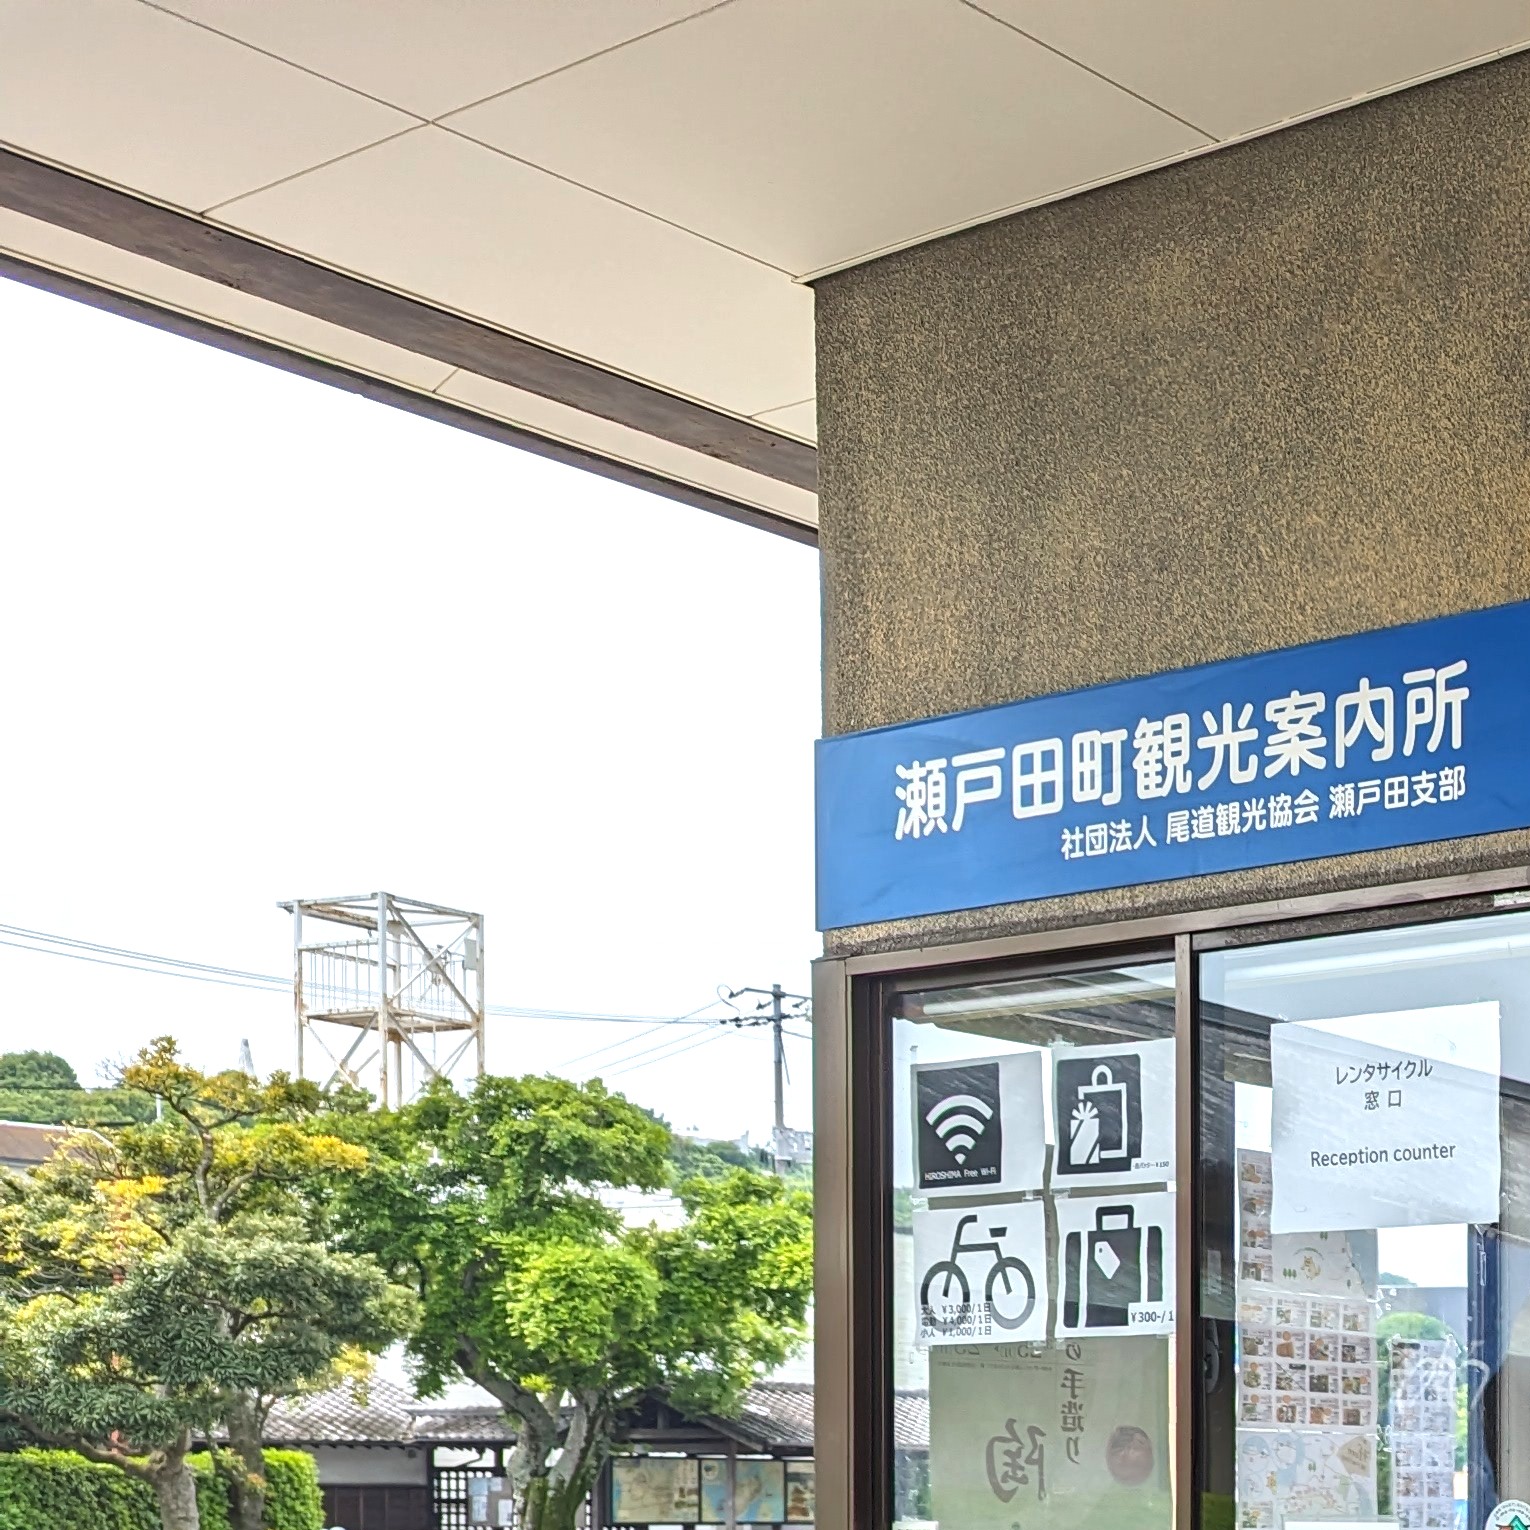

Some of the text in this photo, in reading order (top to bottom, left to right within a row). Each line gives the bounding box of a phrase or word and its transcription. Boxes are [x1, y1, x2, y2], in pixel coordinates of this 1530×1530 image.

[894, 659, 1470, 840] 瀬戸田町観光案内所
[1061, 765, 1467, 860] 社団法人 尾道観光協会 瀬戸田支部
[1336, 1058, 1433, 1085] レンタサイクル
[1311, 1143, 1456, 1167] Reception counter
[963, 1168, 978, 1178] Free
